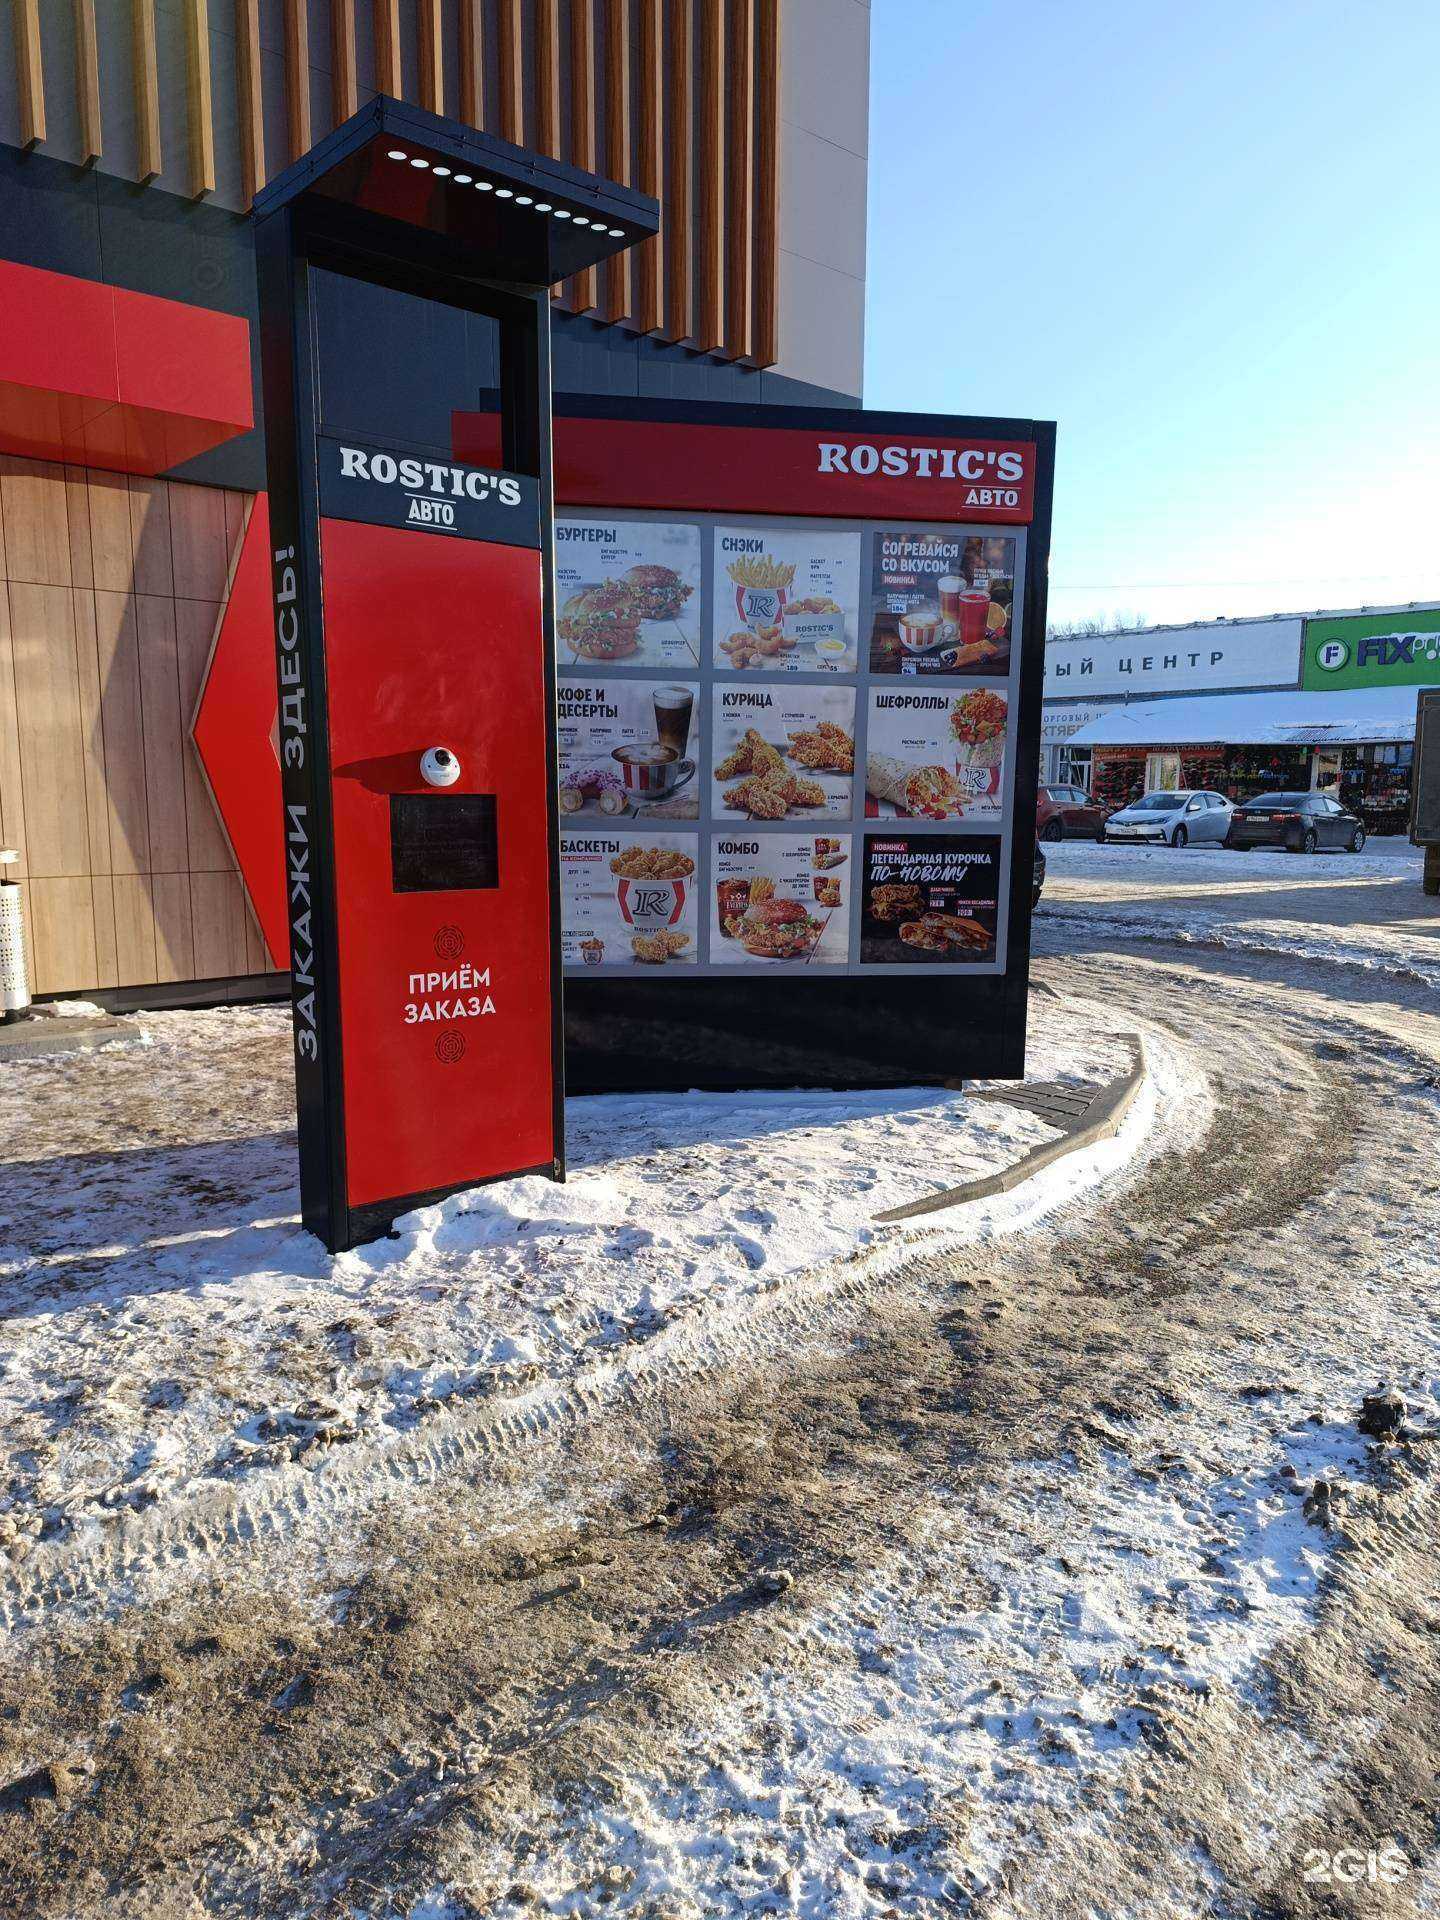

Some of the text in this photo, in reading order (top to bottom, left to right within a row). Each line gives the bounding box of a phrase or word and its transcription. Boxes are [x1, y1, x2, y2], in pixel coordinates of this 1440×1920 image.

[817, 443, 1024, 481] ROSTIC'S
[339, 447, 521, 506] ROSTIC'S
[965, 489, 1019, 507] АВТО
[408, 499, 455, 525] АВТО
[556, 527, 617, 542] БУРГЕРЫ
[722, 537, 763, 553] СНЭКИ
[882, 538, 959, 557] СОГРЕВАЙСЯ
[882, 558, 950, 573] СО ВКУСОМ
[884, 575, 915, 585] НОВИНКА
[1118, 651, 1224, 674] ЦЕНТР
[1325, 646, 1339, 663] F
[557, 688, 604, 702] КОФЕ И
[722, 693, 773, 708] КУРИЦА
[876, 695, 949, 709] ШЕФРОЛЛЫ
[558, 704, 618, 719] ДЕСЕРТЫ
[275, 545, 318, 1061] ЗАКАЖИ ЗДЕСЬ!
[560, 840, 620, 853] БАСКЕТЫ
[718, 842, 759, 855] КОМБО
[873, 843, 905, 852] НОВИНКА
[871, 853, 991, 865] ЛЕГЕНДАРНАЯ КУРОЧКА
[870, 865, 968, 882] ПО-НОВОМУ
[409, 963, 490, 994] ПРИЁМ
[404, 995, 496, 1024] ЗАКАЗА
